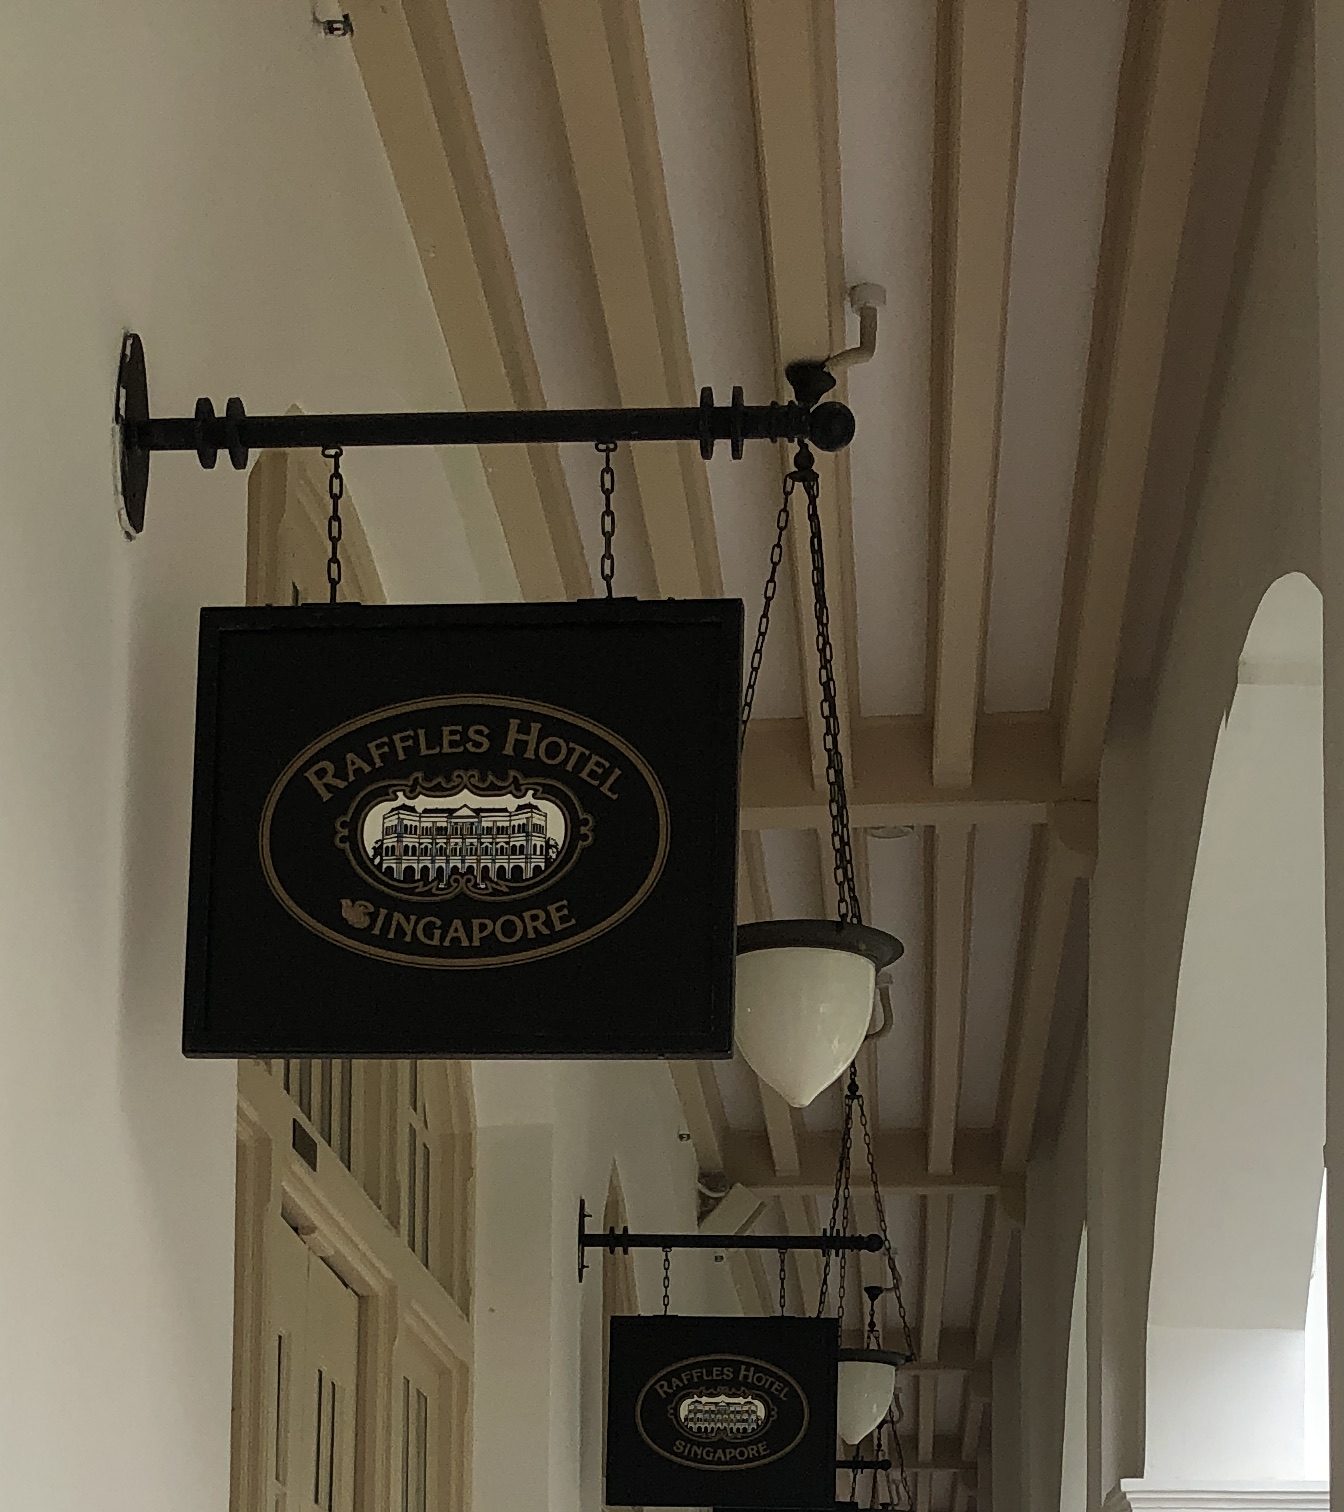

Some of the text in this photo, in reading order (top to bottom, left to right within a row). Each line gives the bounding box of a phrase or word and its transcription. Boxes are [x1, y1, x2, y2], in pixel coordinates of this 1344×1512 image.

[303, 718, 625, 802] RAFFLES HOTEL
[340, 898, 576, 947] SINGAPORE
[655, 1365, 790, 1400] RAFFLES HOTEL
[674, 1440, 770, 1461] SINGAPORE
